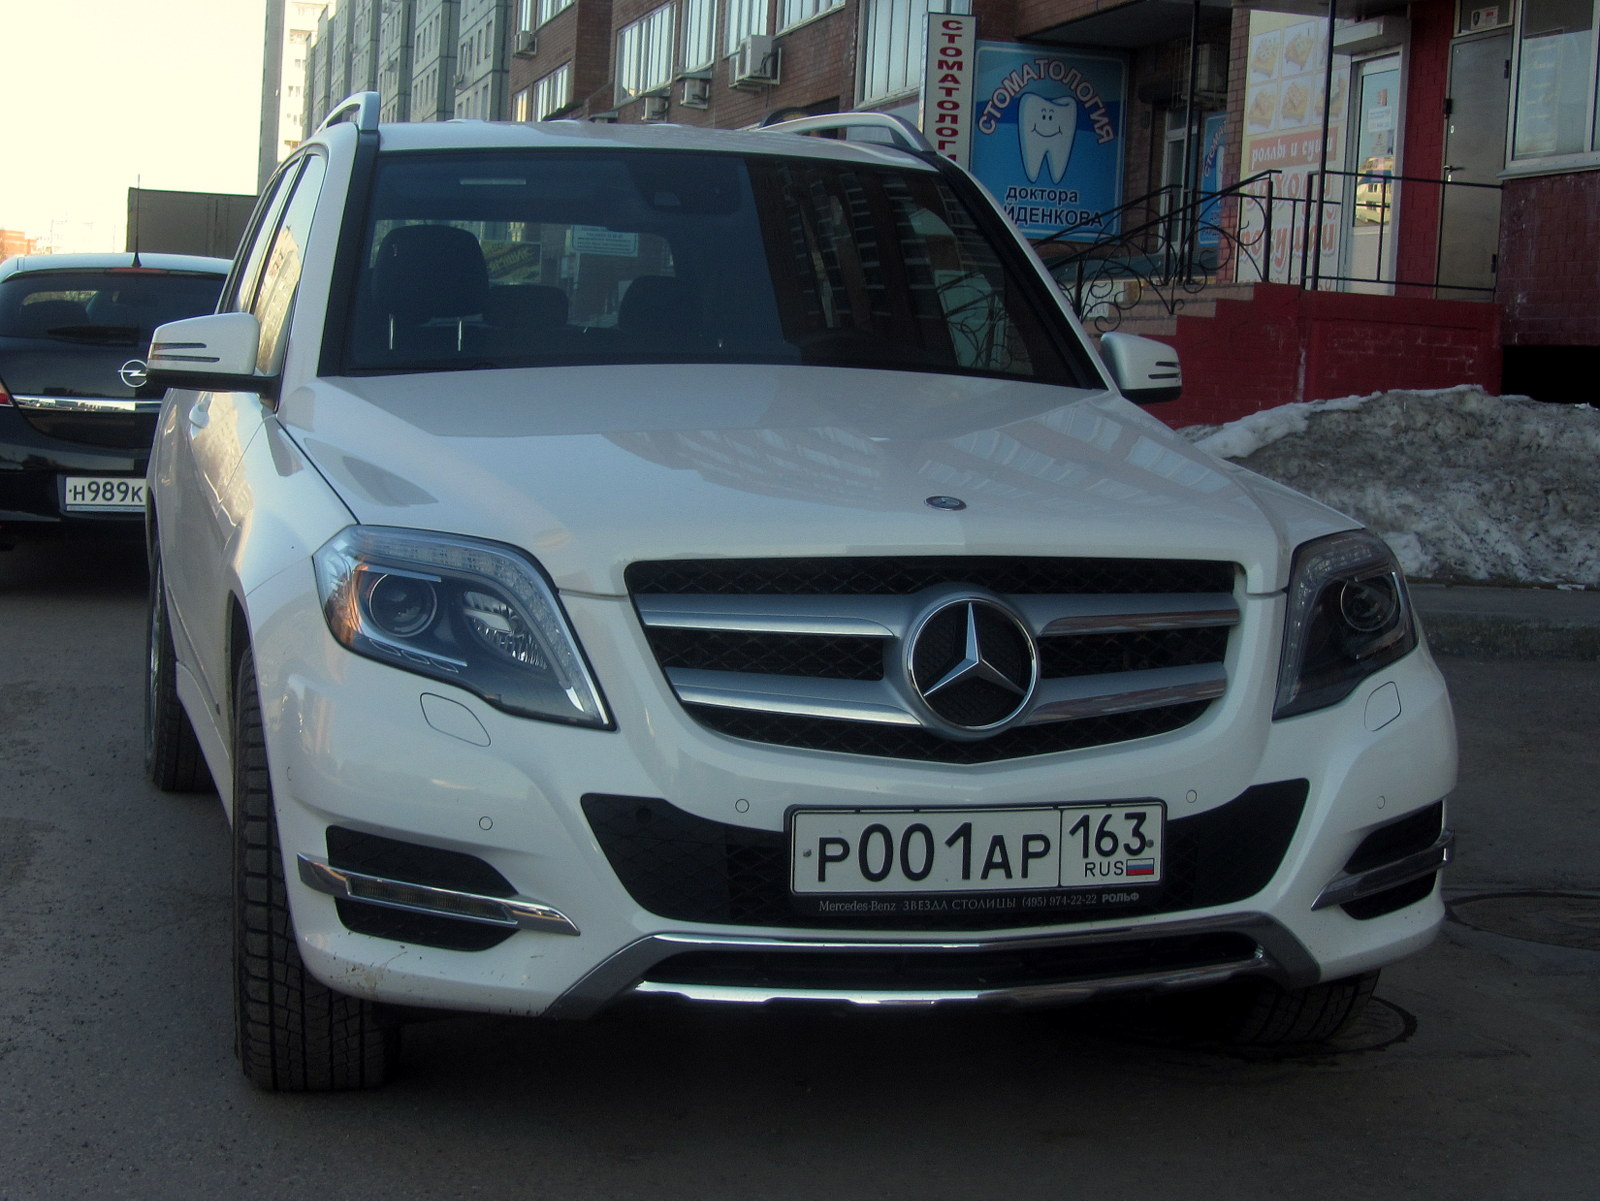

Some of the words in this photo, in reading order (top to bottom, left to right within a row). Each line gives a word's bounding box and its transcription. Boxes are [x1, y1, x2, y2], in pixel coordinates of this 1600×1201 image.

[978, 58, 1115, 145] СТОМАТОЛОГИЯ
[1252, 139, 1286, 170] роллы
[1291, 143, 1298, 157] и
[1006, 187, 1078, 203] доктора
[1004, 204, 1103, 227] ЙДЕНКОВА
[1068, 811, 1147, 859] 163
[1084, 861, 1124, 877] RUS
[818, 900, 897, 912] Mercedes-Benz
[902, 899, 948, 912] ЗВЕЗДА
[952, 897, 1017, 911] СТОЛИЦЫ
[1022, 896, 1047, 909] (495)
[1049, 894, 1097, 907] 974-22-22
[1101, 892, 1140, 903] РОЛЬФ
